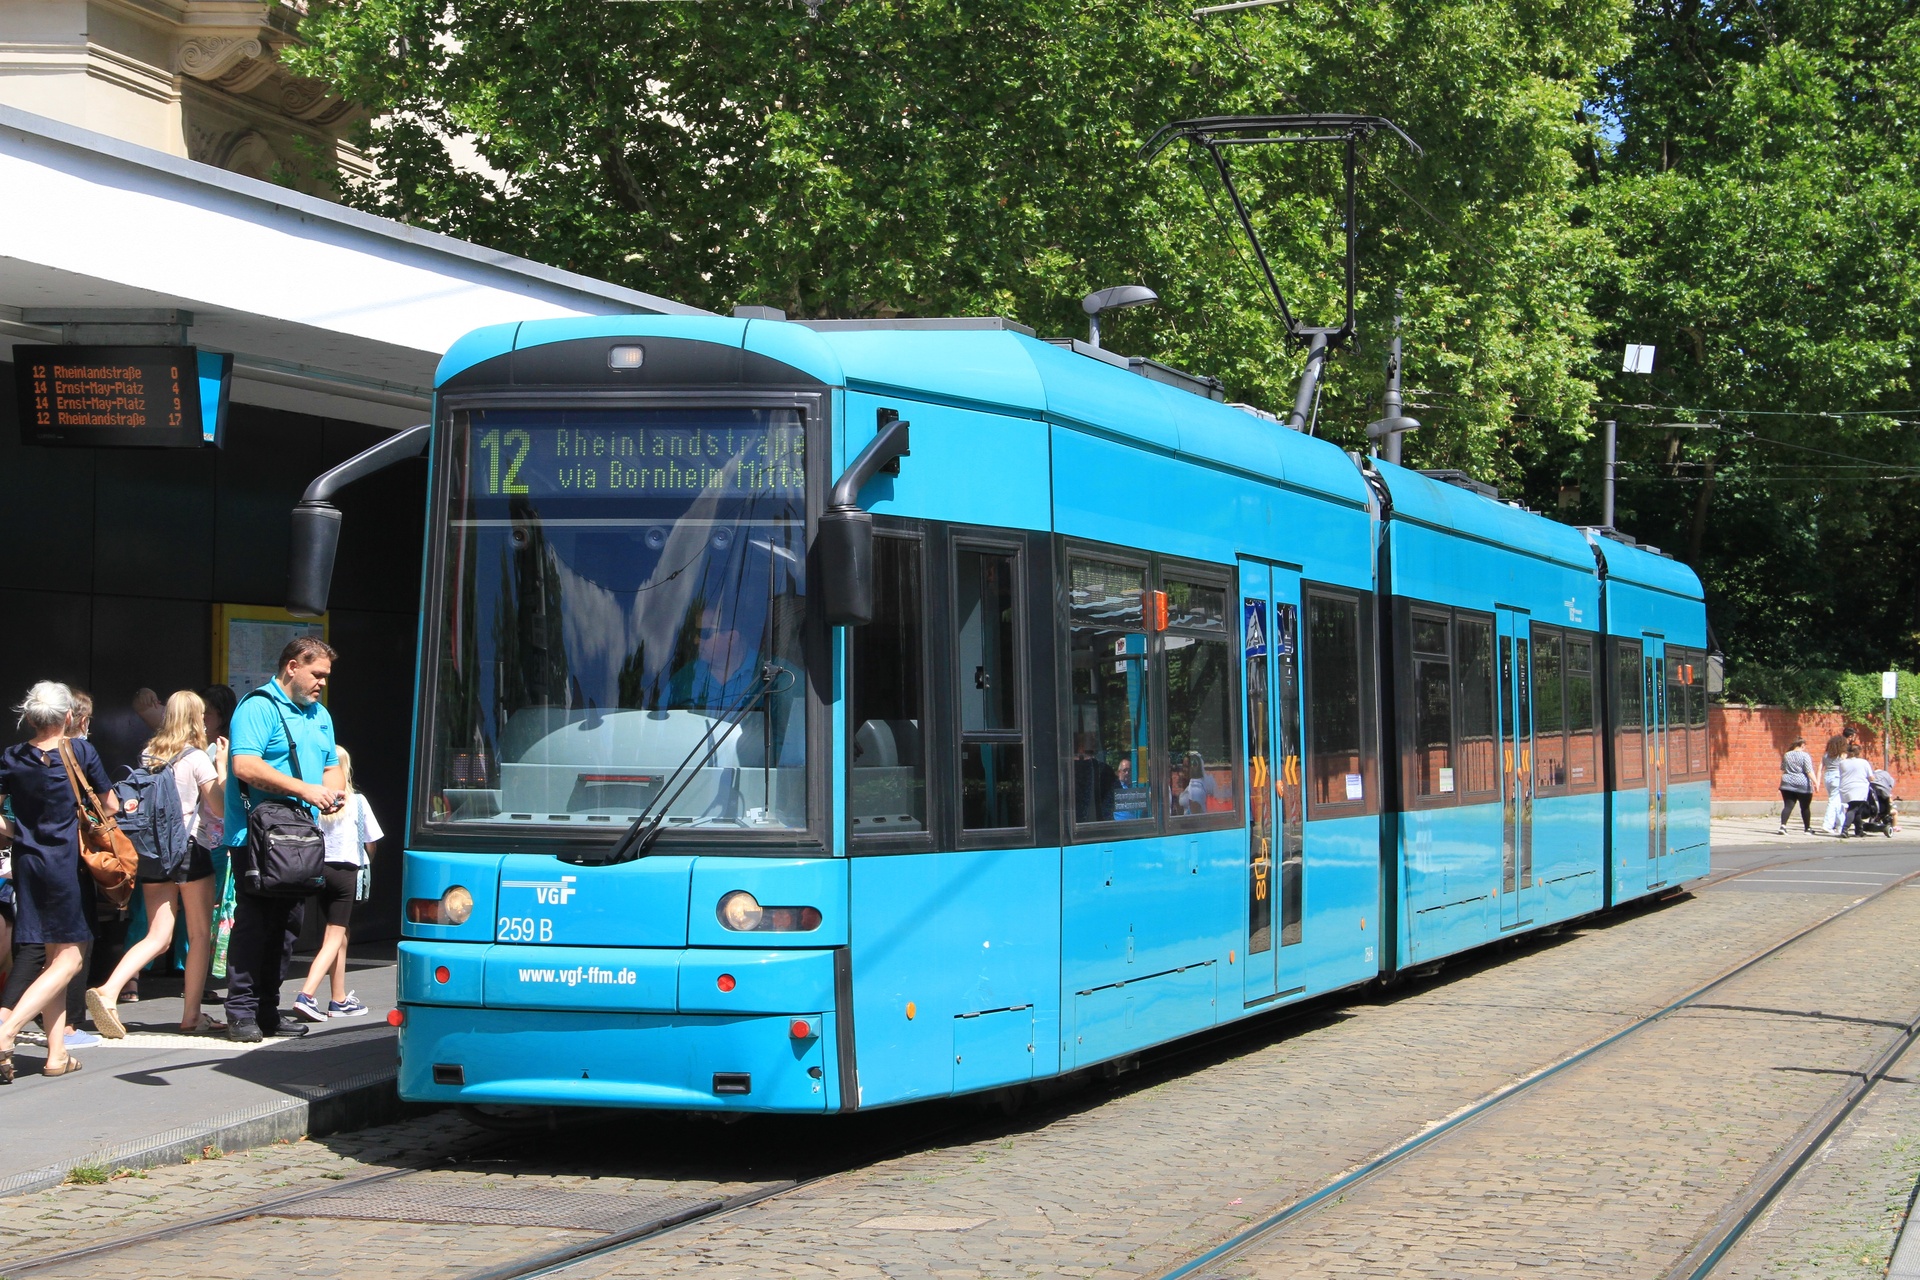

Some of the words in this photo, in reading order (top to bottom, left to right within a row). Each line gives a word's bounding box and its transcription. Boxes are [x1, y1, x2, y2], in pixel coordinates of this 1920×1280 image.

[32, 366, 46, 378] 12
[54, 366, 142, 380] Rheinlandstraße
[171, 367, 178, 379] 0
[34, 382, 47, 394] 14
[56, 382, 144, 396] Ernst-May-Platz
[172, 382, 180, 394] 4
[36, 397, 48, 409] 14
[57, 397, 146, 412] Ernst-May-Platz
[174, 398, 181, 410] 9
[37, 412, 50, 424] 12
[58, 412, 146, 427] Rheinlandstraße
[169, 413, 182, 426] 17
[556, 428, 805, 460] Rheinlandstraße
[480, 428, 530, 494] 12
[559, 463, 597, 488] via
[610, 460, 723, 489] Bornheim
[736, 460, 804, 489] Mitte
[537, 876, 576, 905] VGF
[498, 917, 534, 941] 259
[540, 918, 552, 942] B
[518, 967, 636, 987] www.vgf-ffm.de
